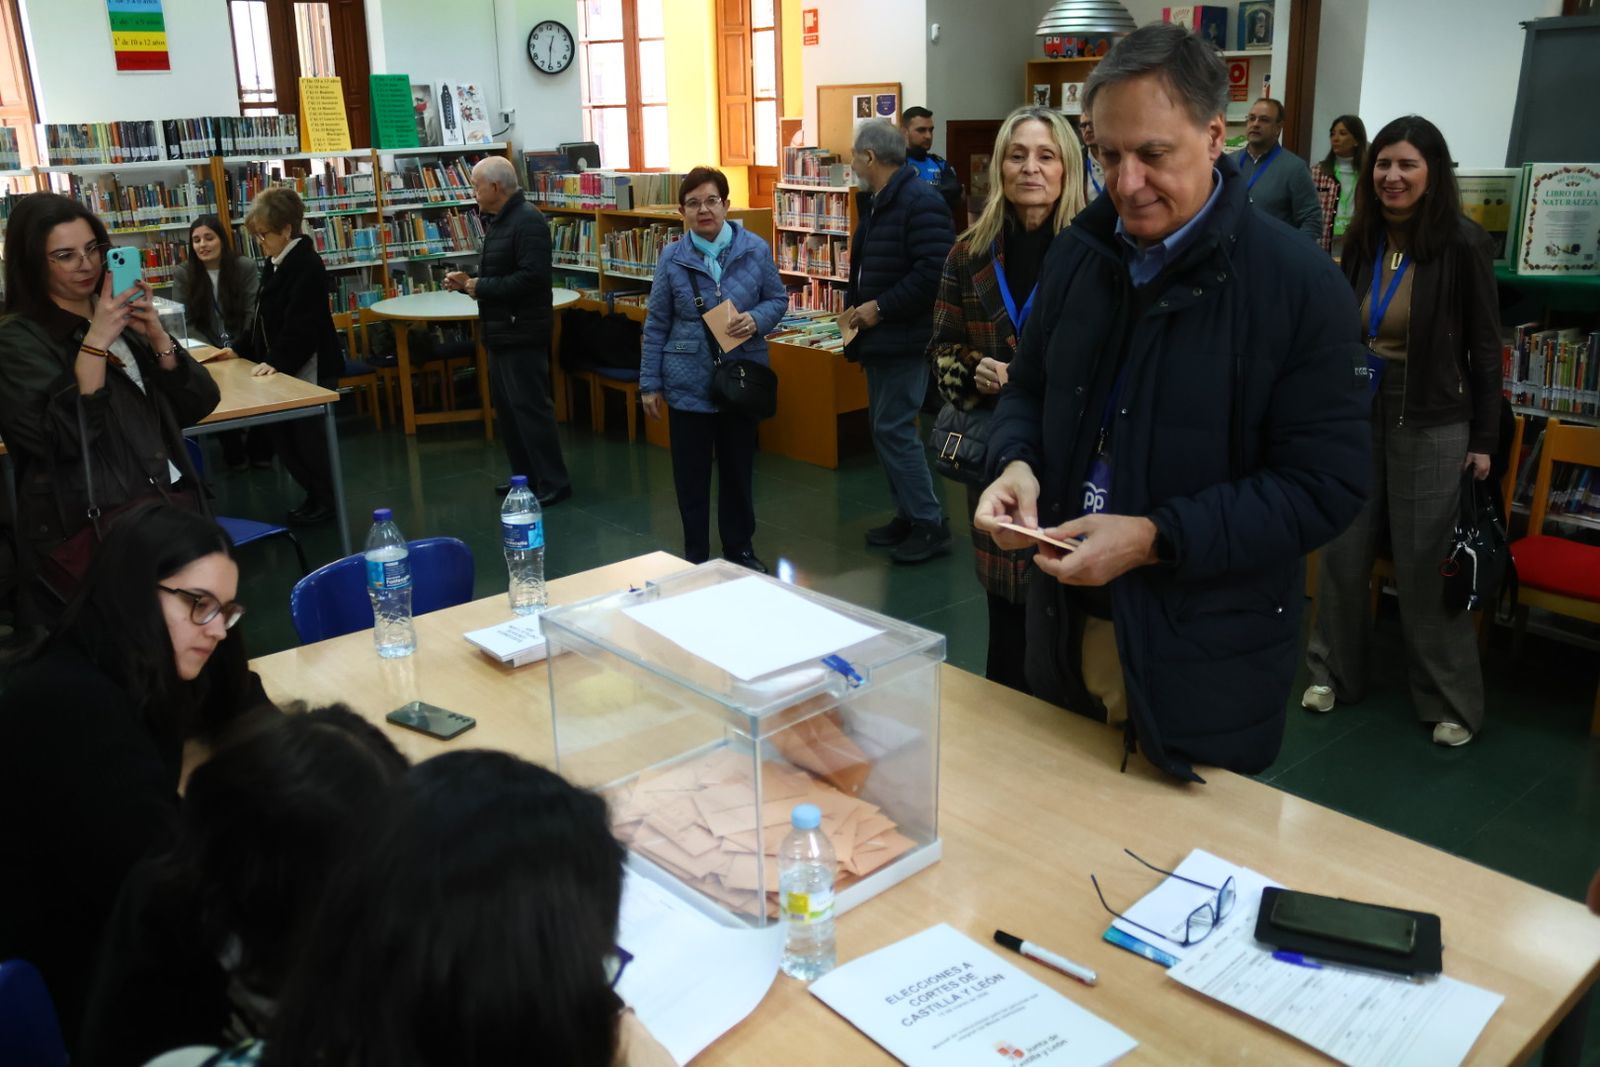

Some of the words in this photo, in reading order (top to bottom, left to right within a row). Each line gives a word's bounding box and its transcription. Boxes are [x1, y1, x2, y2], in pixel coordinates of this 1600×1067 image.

[1542, 198, 1600, 206] NATURALEZA
[884, 966, 962, 1005] ELECCIONES
[962, 961, 974, 970] A
[901, 994, 961, 1027] CASTILLA
[961, 988, 970, 997] Y
[971, 973, 1006, 992] LEÓN
[908, 980, 960, 1007] CORTES
[958, 972, 978, 984] DE
[1027, 1040, 1048, 1053] Junta
[1048, 1033, 1058, 1042] de
